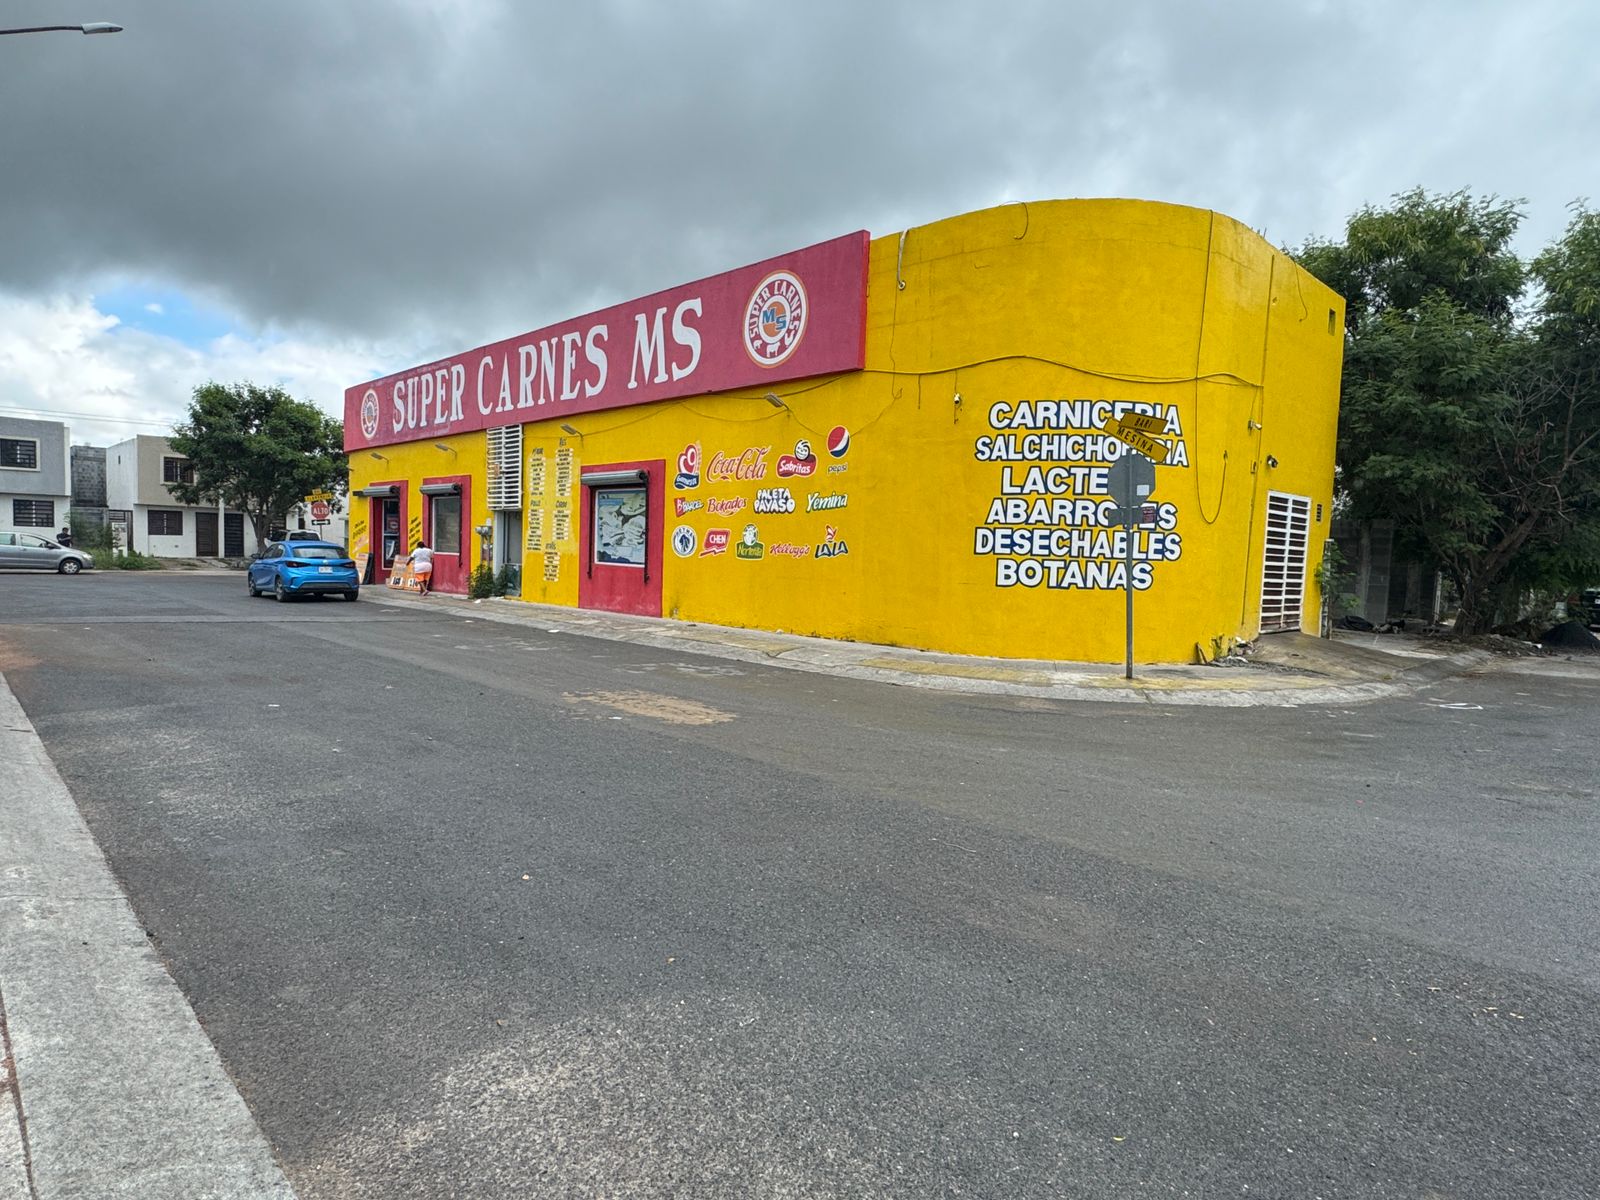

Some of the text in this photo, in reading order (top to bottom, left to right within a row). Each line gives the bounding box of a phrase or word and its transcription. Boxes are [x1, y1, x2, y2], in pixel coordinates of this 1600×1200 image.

[748, 280, 801, 339] SUPER CARNES
[763, 306, 787, 332] MS
[392, 363, 466, 434] SUPER
[477, 324, 609, 416] CARNES
[627, 297, 703, 390] MS
[975, 433, 1190, 468] SALCHICHOIA
[1118, 426, 1155, 454] MESINA
[780, 460, 811, 474] Sabritas
[828, 463, 848, 475] pepsi
[1001, 466, 1110, 496] LACTE
[707, 497, 747, 513] Bokados
[757, 487, 792, 501] PALETA
[806, 492, 848, 512] Yemina
[312, 507, 329, 515] ALTO
[753, 498, 796, 514] PAYASO
[985, 497, 1179, 531] ABARROS
[709, 534, 727, 544] CHEN
[815, 541, 848, 558] LALA
[974, 527, 1182, 561] DESECHABLES
[996, 557, 1155, 591] BOTANAS
